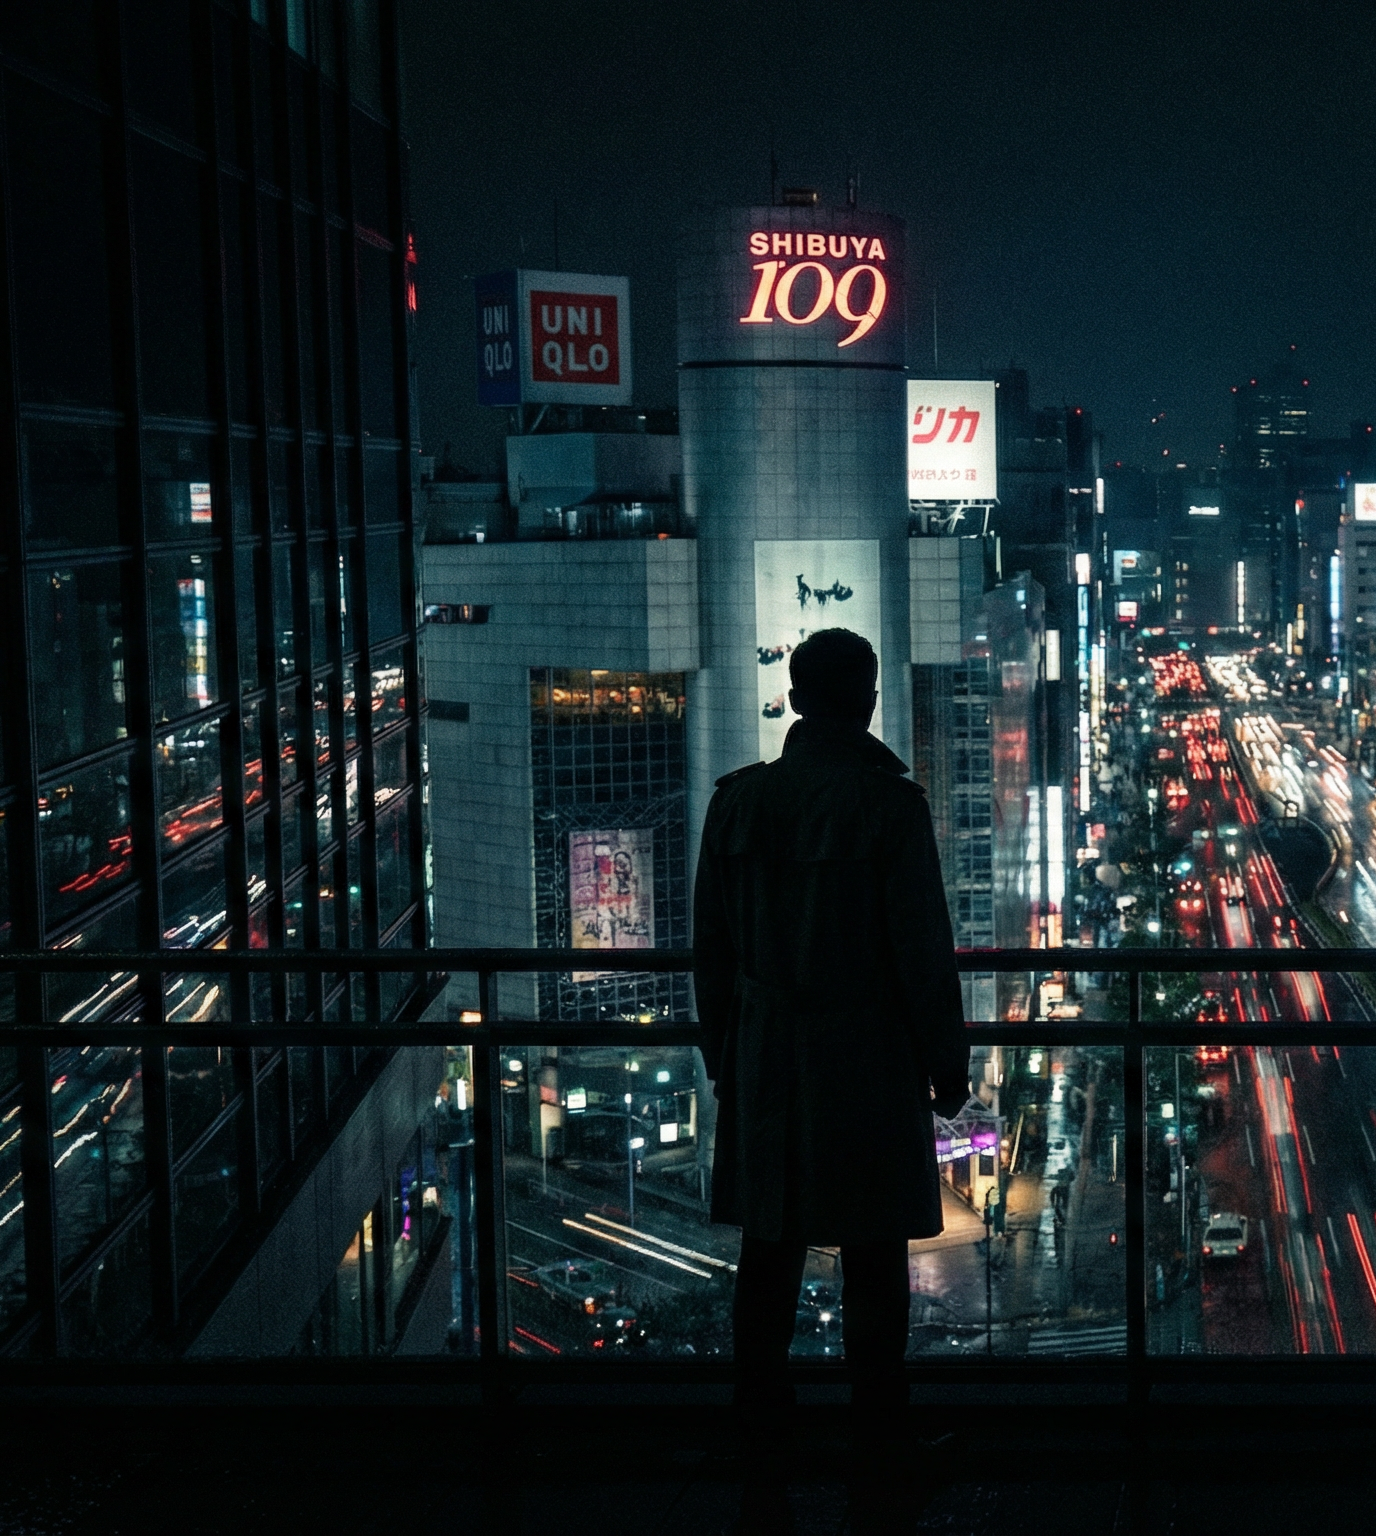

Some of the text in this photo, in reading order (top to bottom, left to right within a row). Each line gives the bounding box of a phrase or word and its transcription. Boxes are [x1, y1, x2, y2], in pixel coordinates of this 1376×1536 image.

[750, 232, 886, 261] SHIBUYA
[484, 304, 509, 335] UNI
[541, 304, 603, 337] UNI
[740, 261, 887, 348] 109
[484, 340, 512, 378] QLO
[542, 340, 609, 377] QLO
